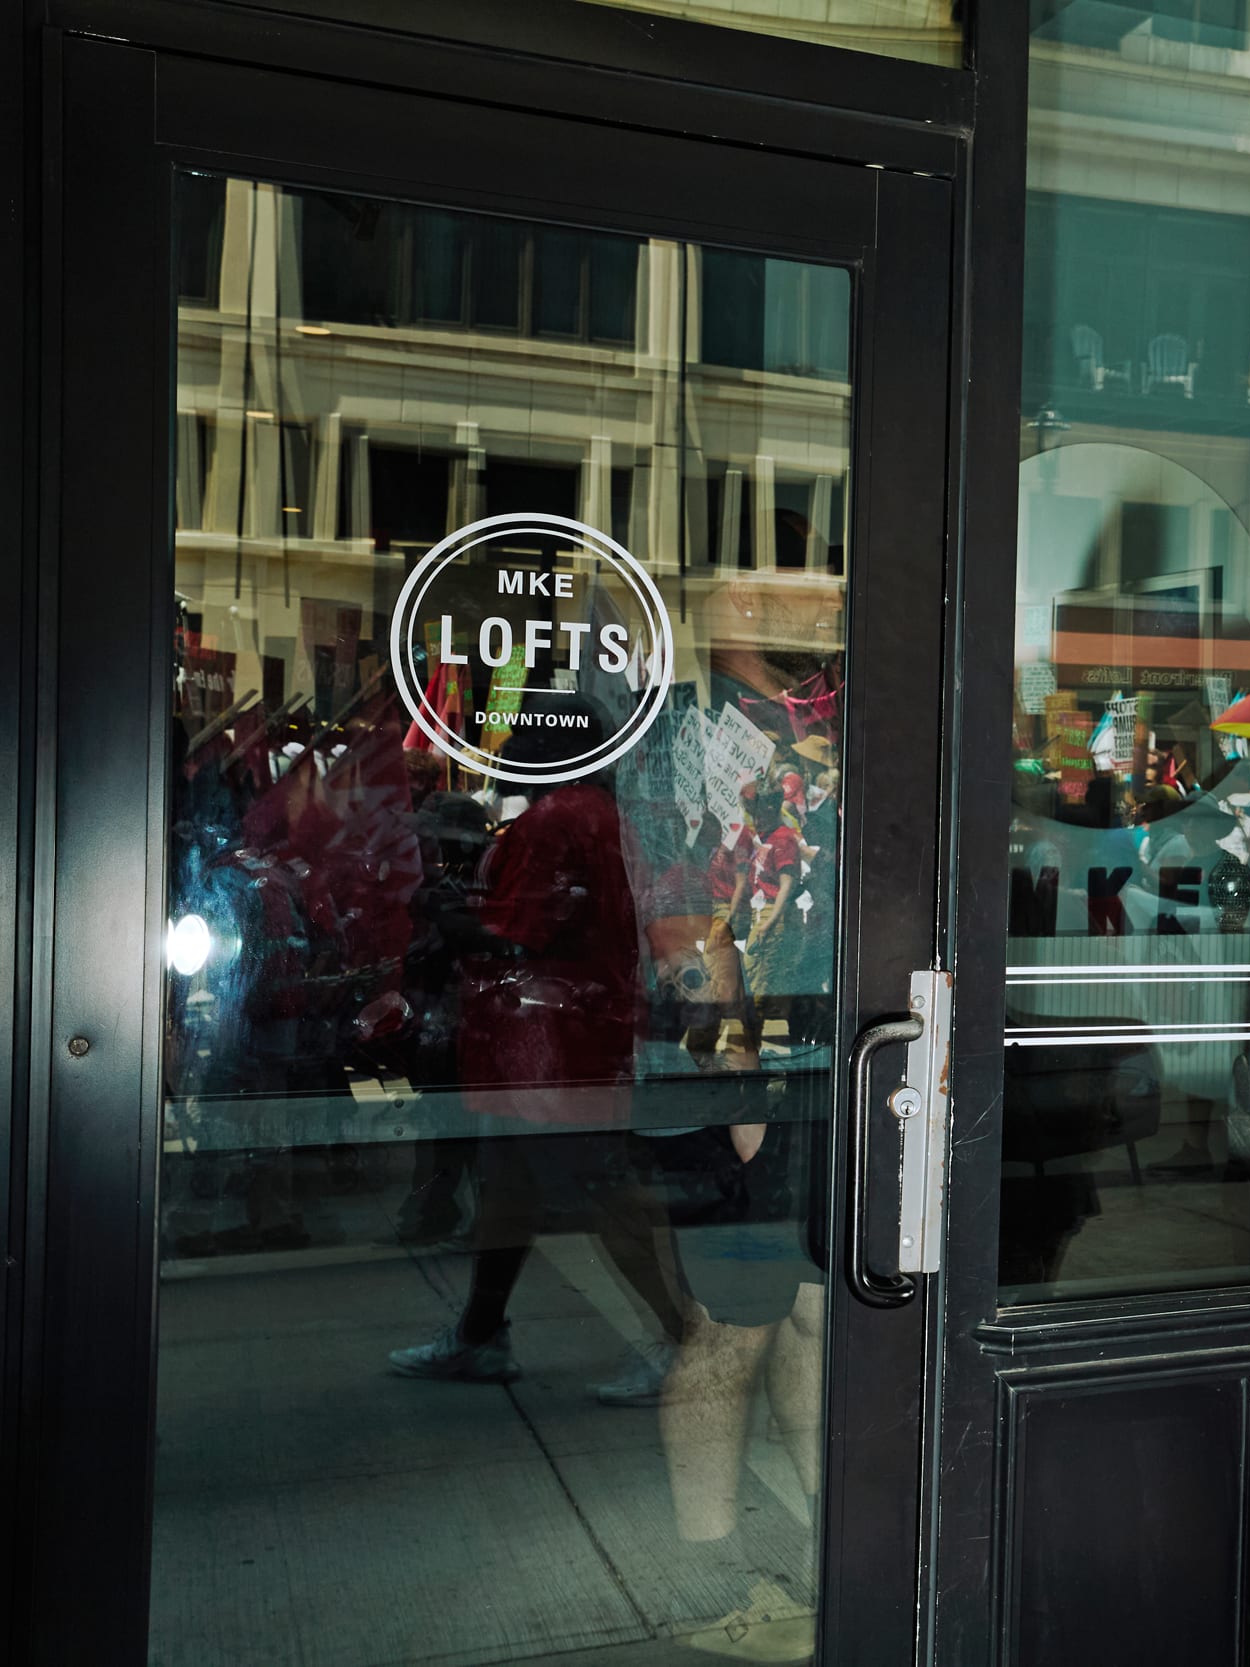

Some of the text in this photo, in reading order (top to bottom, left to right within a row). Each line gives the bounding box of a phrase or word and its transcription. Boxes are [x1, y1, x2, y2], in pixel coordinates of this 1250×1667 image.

[497, 569, 575, 599] MKE
[439, 614, 630, 674] LOFTS
[474, 710, 590, 729] DOWNTOWN
